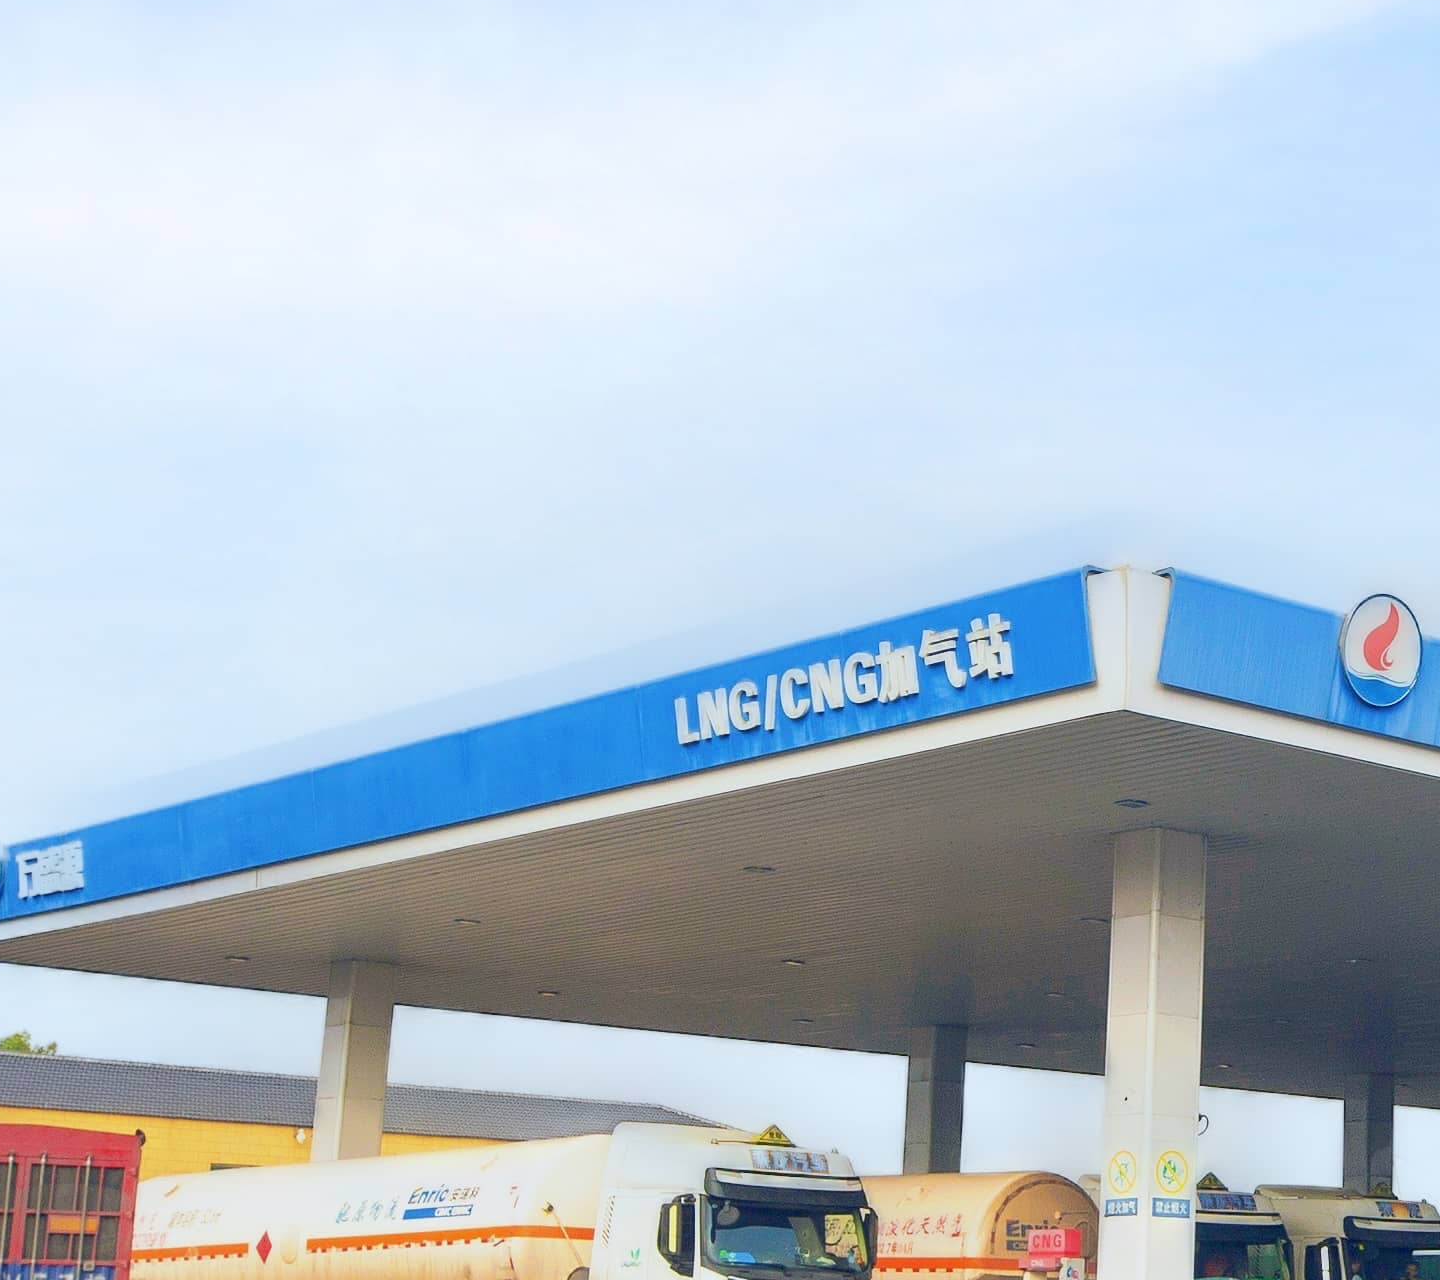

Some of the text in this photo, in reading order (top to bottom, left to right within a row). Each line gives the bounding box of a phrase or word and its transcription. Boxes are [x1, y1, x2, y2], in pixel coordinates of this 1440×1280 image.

[673, 612, 1016, 746] LNG/CNG加气站
[408, 1183, 449, 1205] Enric
[1032, 1233, 1063, 1249] CNG
